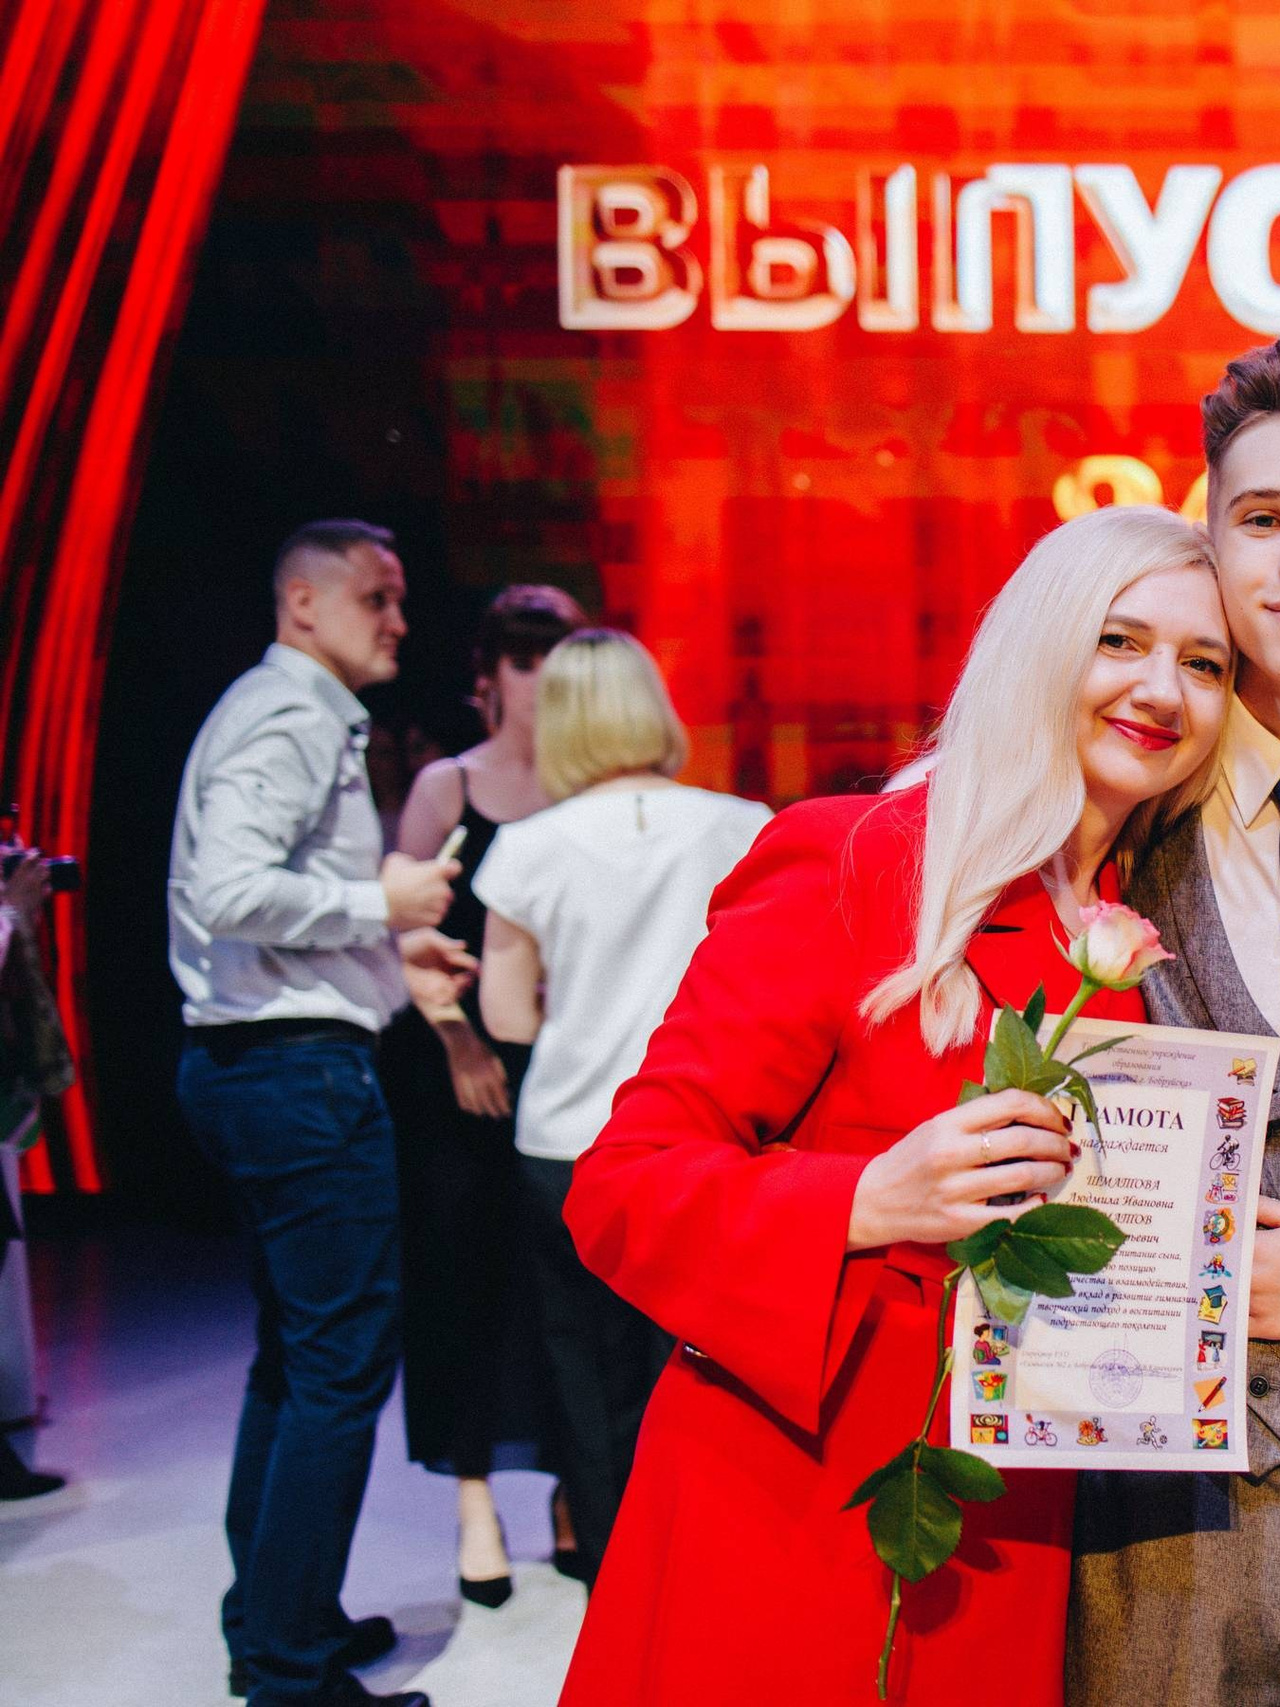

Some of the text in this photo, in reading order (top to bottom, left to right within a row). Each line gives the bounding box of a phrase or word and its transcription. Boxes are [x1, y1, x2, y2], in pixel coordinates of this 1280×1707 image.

[1070, 1103, 1184, 1130] ГАМОТА
[1066, 1191, 1175, 1209] Людмила Ивановна
